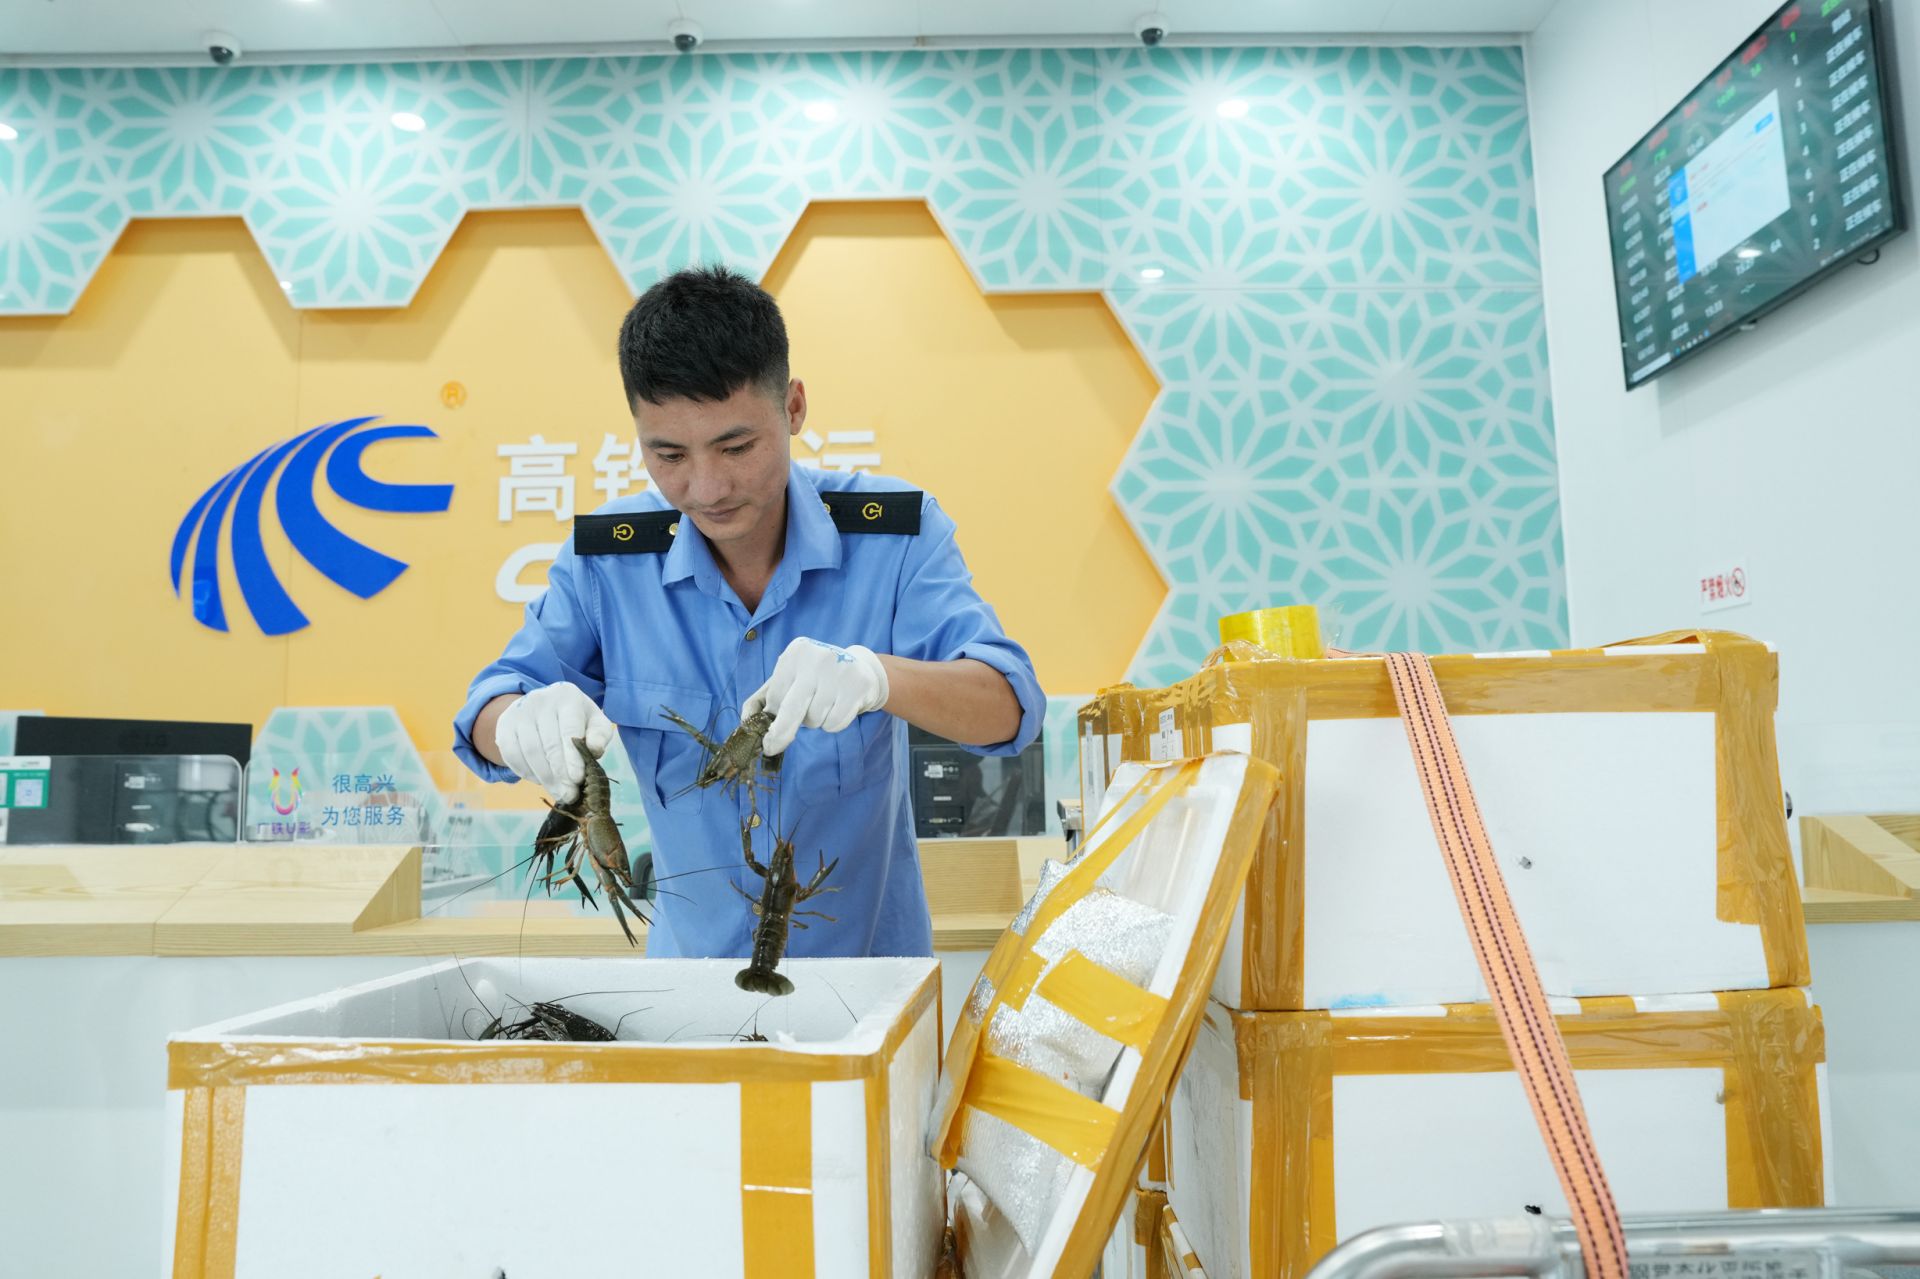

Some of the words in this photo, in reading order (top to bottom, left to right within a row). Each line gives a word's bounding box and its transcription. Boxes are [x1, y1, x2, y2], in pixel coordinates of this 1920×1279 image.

[332, 774, 395, 793] 很高兴
[321, 805, 405, 826] 为您服务
